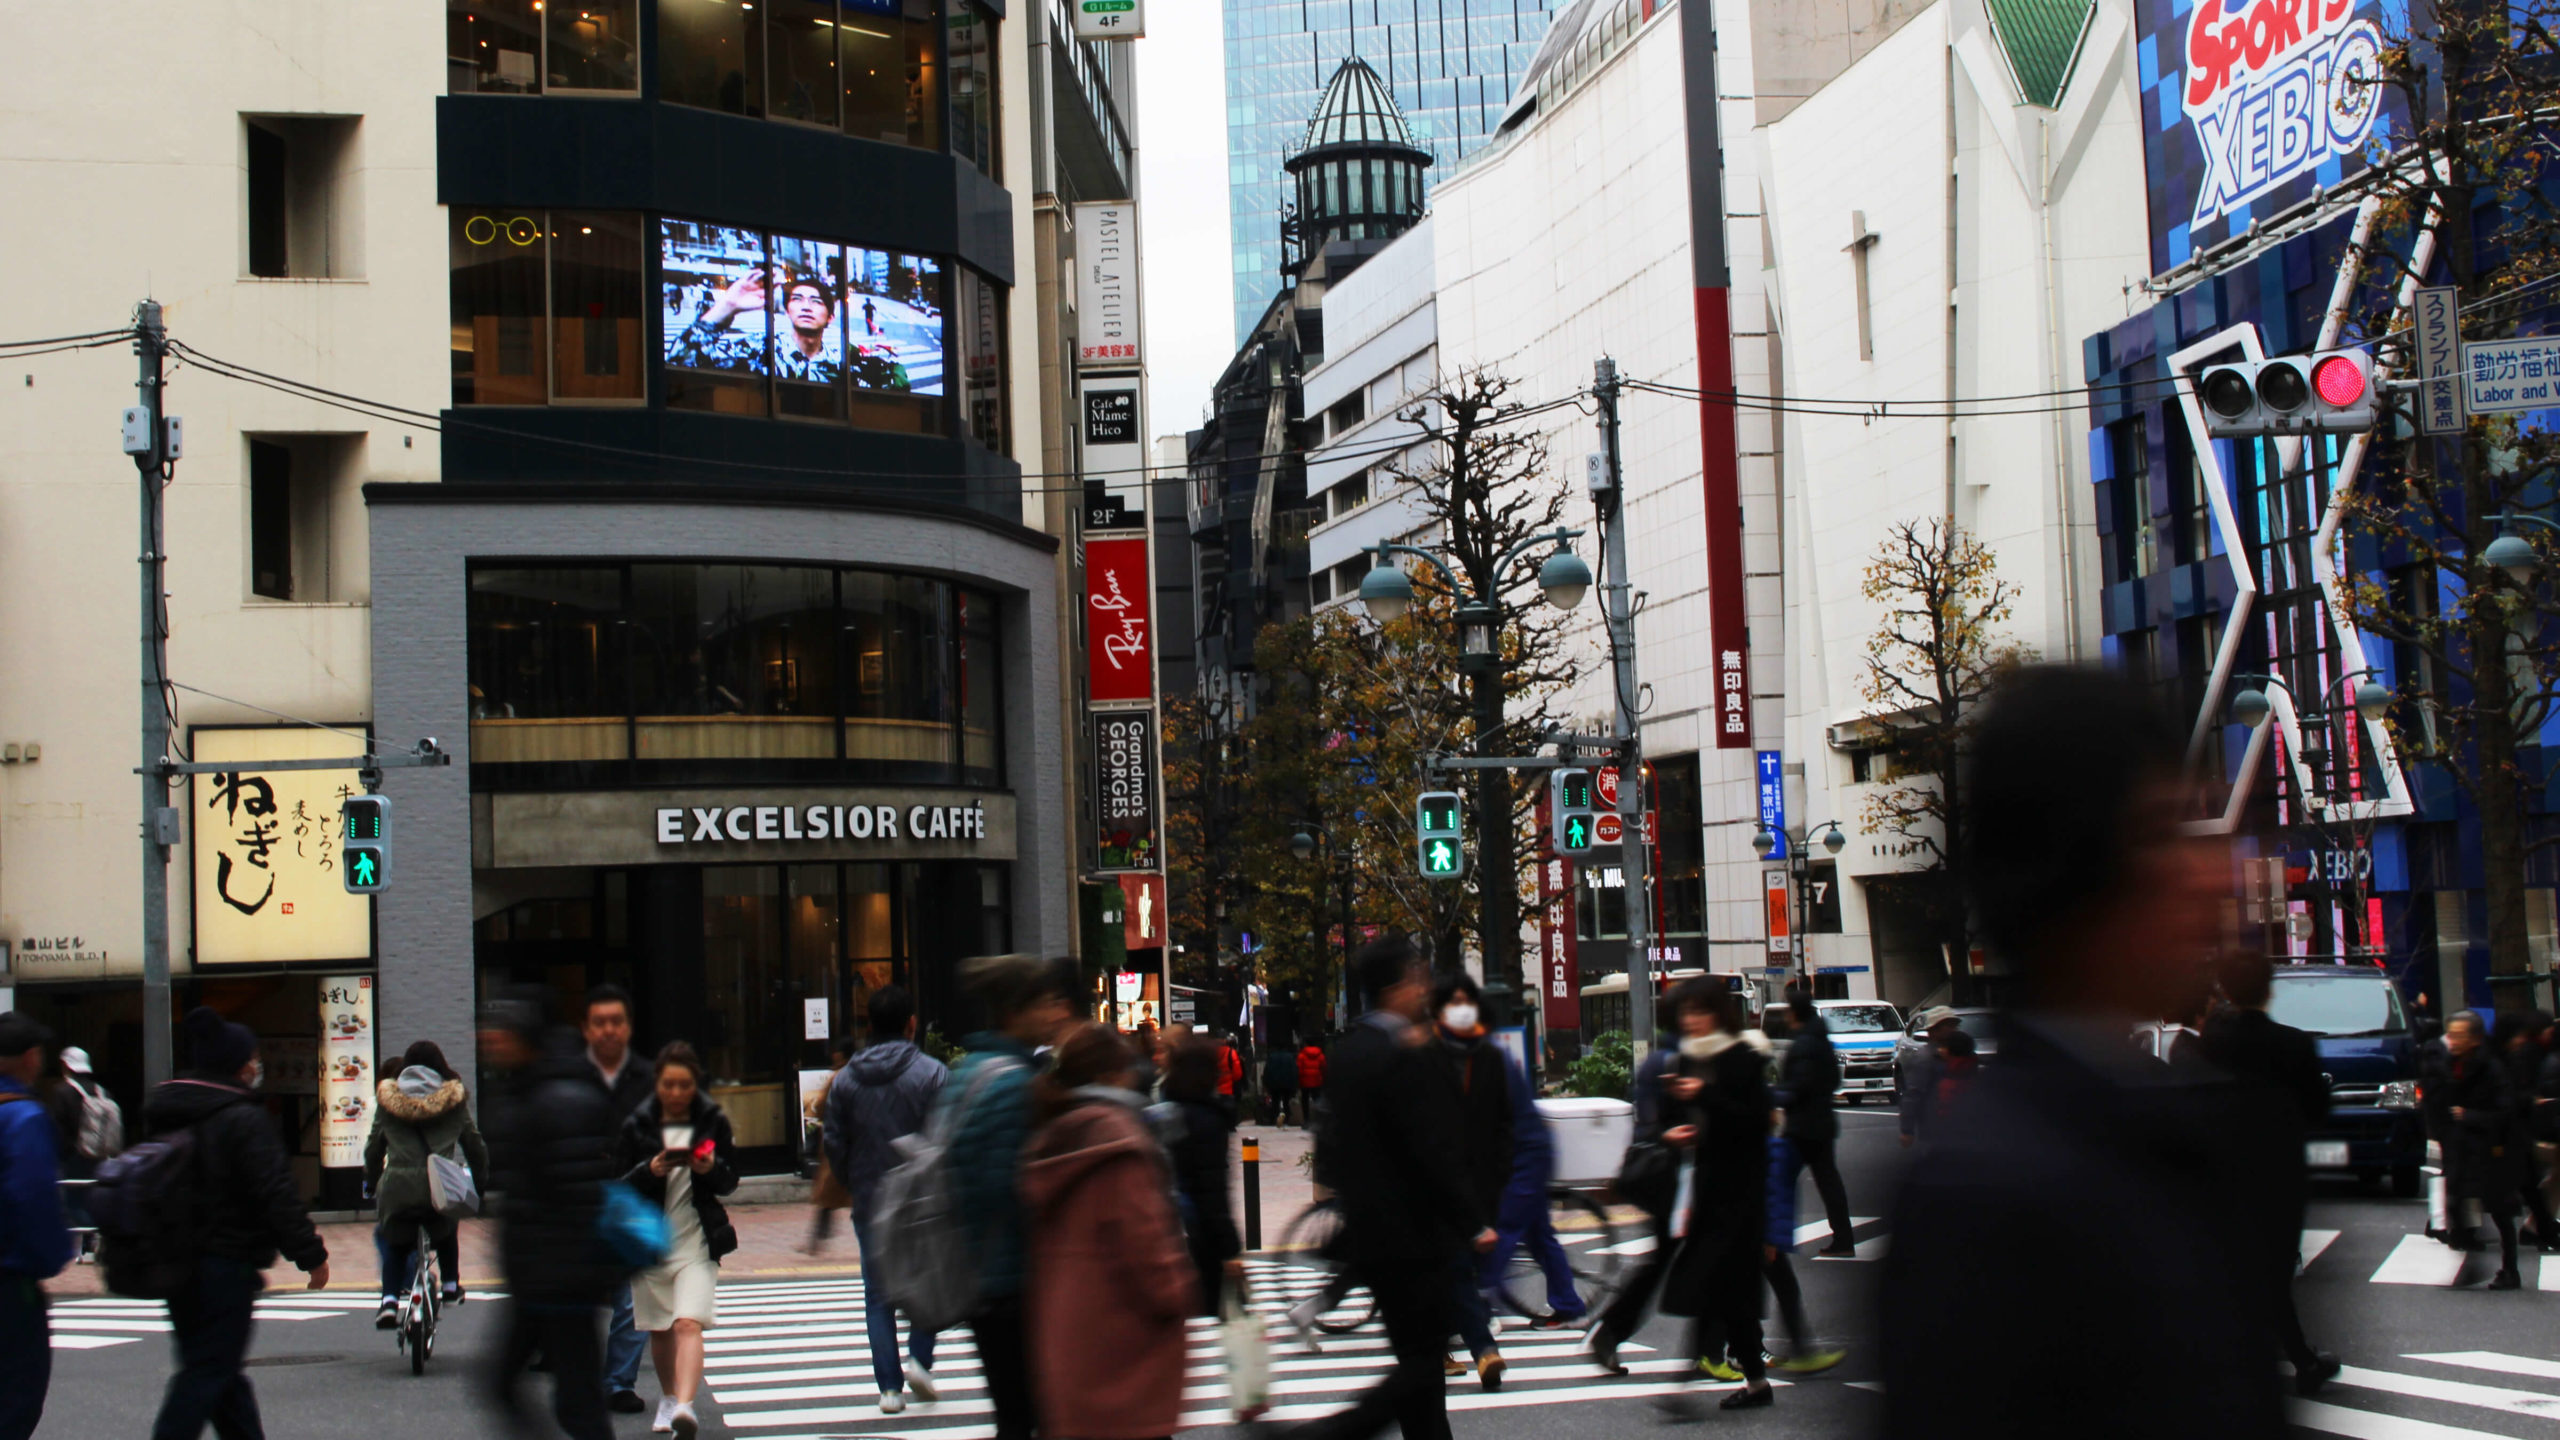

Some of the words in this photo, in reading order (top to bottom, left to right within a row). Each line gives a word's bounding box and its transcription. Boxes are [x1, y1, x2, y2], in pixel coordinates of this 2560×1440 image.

[1099, 16, 1120, 27] 4F
[2188, 0, 2356, 106] SPOR
[2196, 31, 2380, 220] XEBIO
[1100, 211, 1119, 262] PASTEL
[1102, 274, 1122, 338] ATELIER
[1082, 344, 1135, 358] 3F美容室
[2426, 294, 2454, 428] スクランブル交差点
[2475, 386, 2514, 403] Labor
[2522, 382, 2547, 399] and
[1092, 423, 1121, 436] Hico
[1093, 509, 1115, 524] 2F
[1091, 569, 1145, 669] Ray-Ban
[1721, 650, 1744, 733] 無印良品
[1109, 722, 1129, 818] GEORGES
[1129, 721, 1147, 817] Grandma's
[209, 771, 281, 915] ねぎし
[291, 800, 312, 858] 麦めし
[319, 814, 333, 872] とろろ
[657, 805, 898, 843] EXCELSIOR
[910, 800, 985, 840] CAFFÉ
[1600, 826, 1620, 836] ガスト
[1548, 860, 1567, 998] 無印良品
